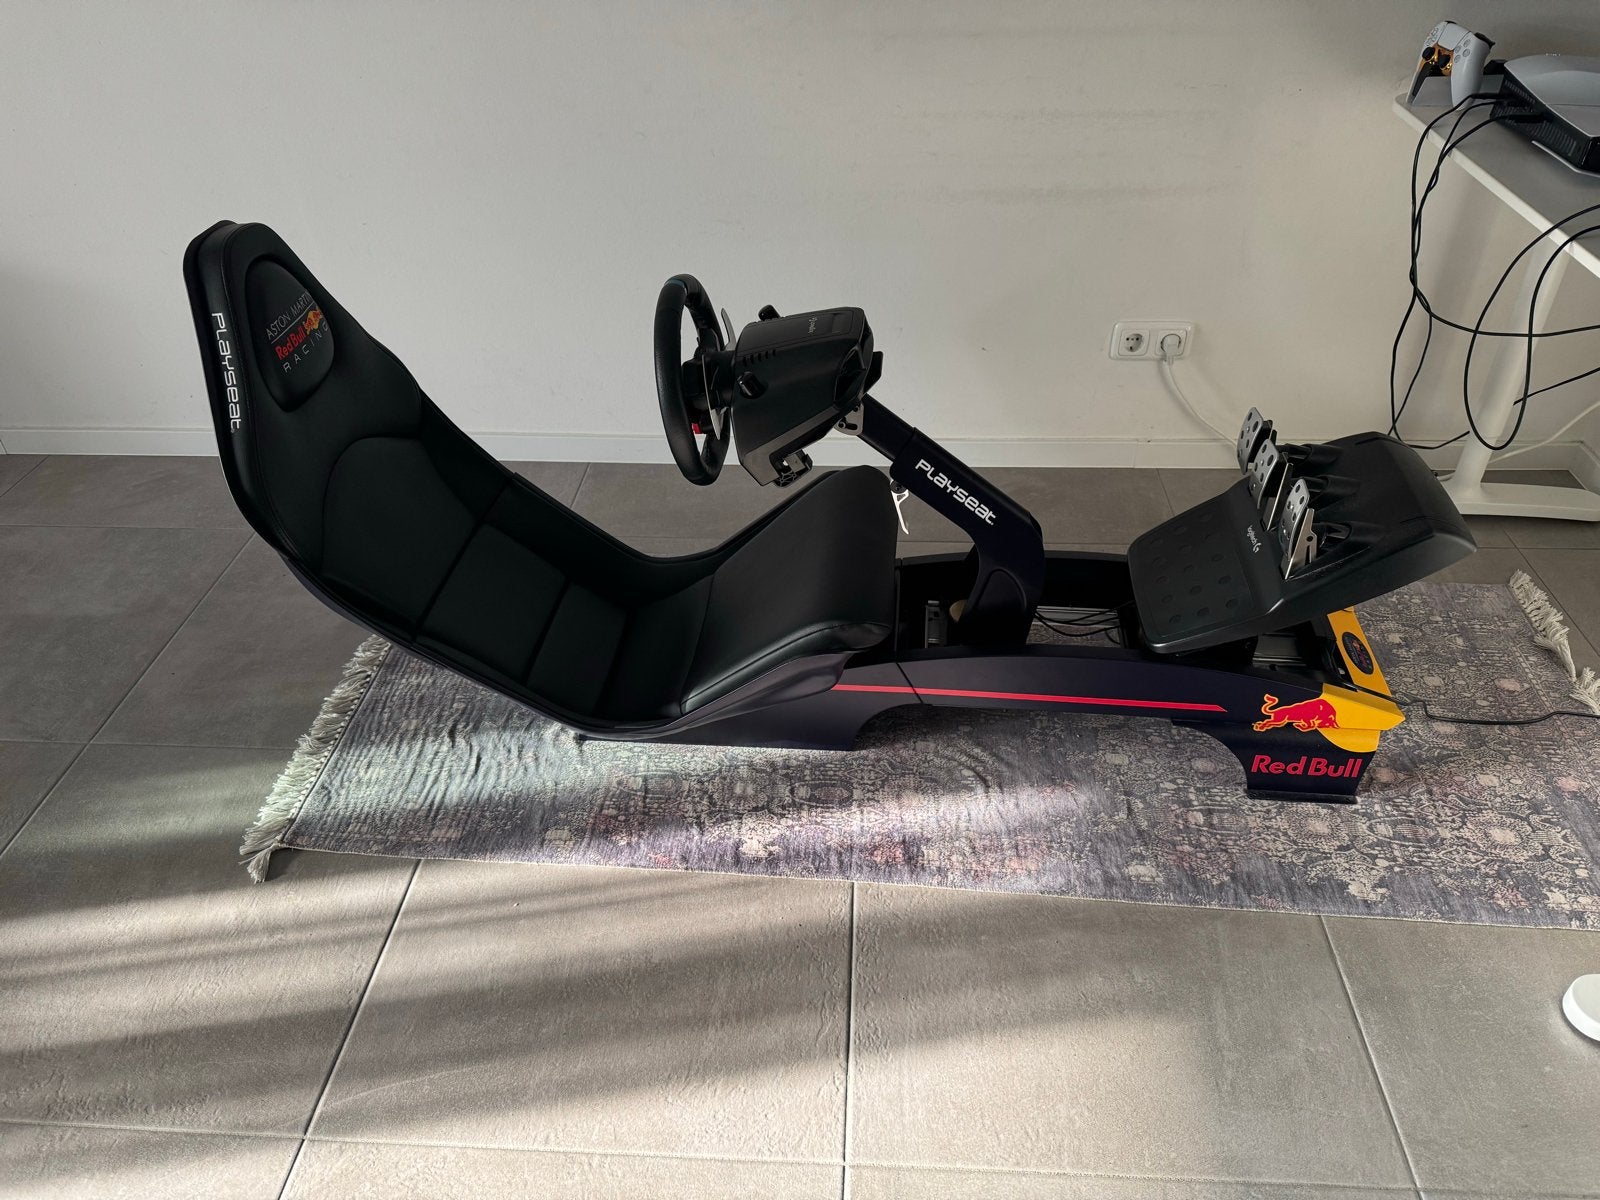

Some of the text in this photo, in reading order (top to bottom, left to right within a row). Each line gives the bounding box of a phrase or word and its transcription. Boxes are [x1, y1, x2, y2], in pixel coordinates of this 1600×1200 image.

[265, 313, 291, 340] ASTON
[275, 325, 306, 361] Red Bull
[282, 322, 329, 373] RACING
[1251, 755, 1362, 778] Red Bull
